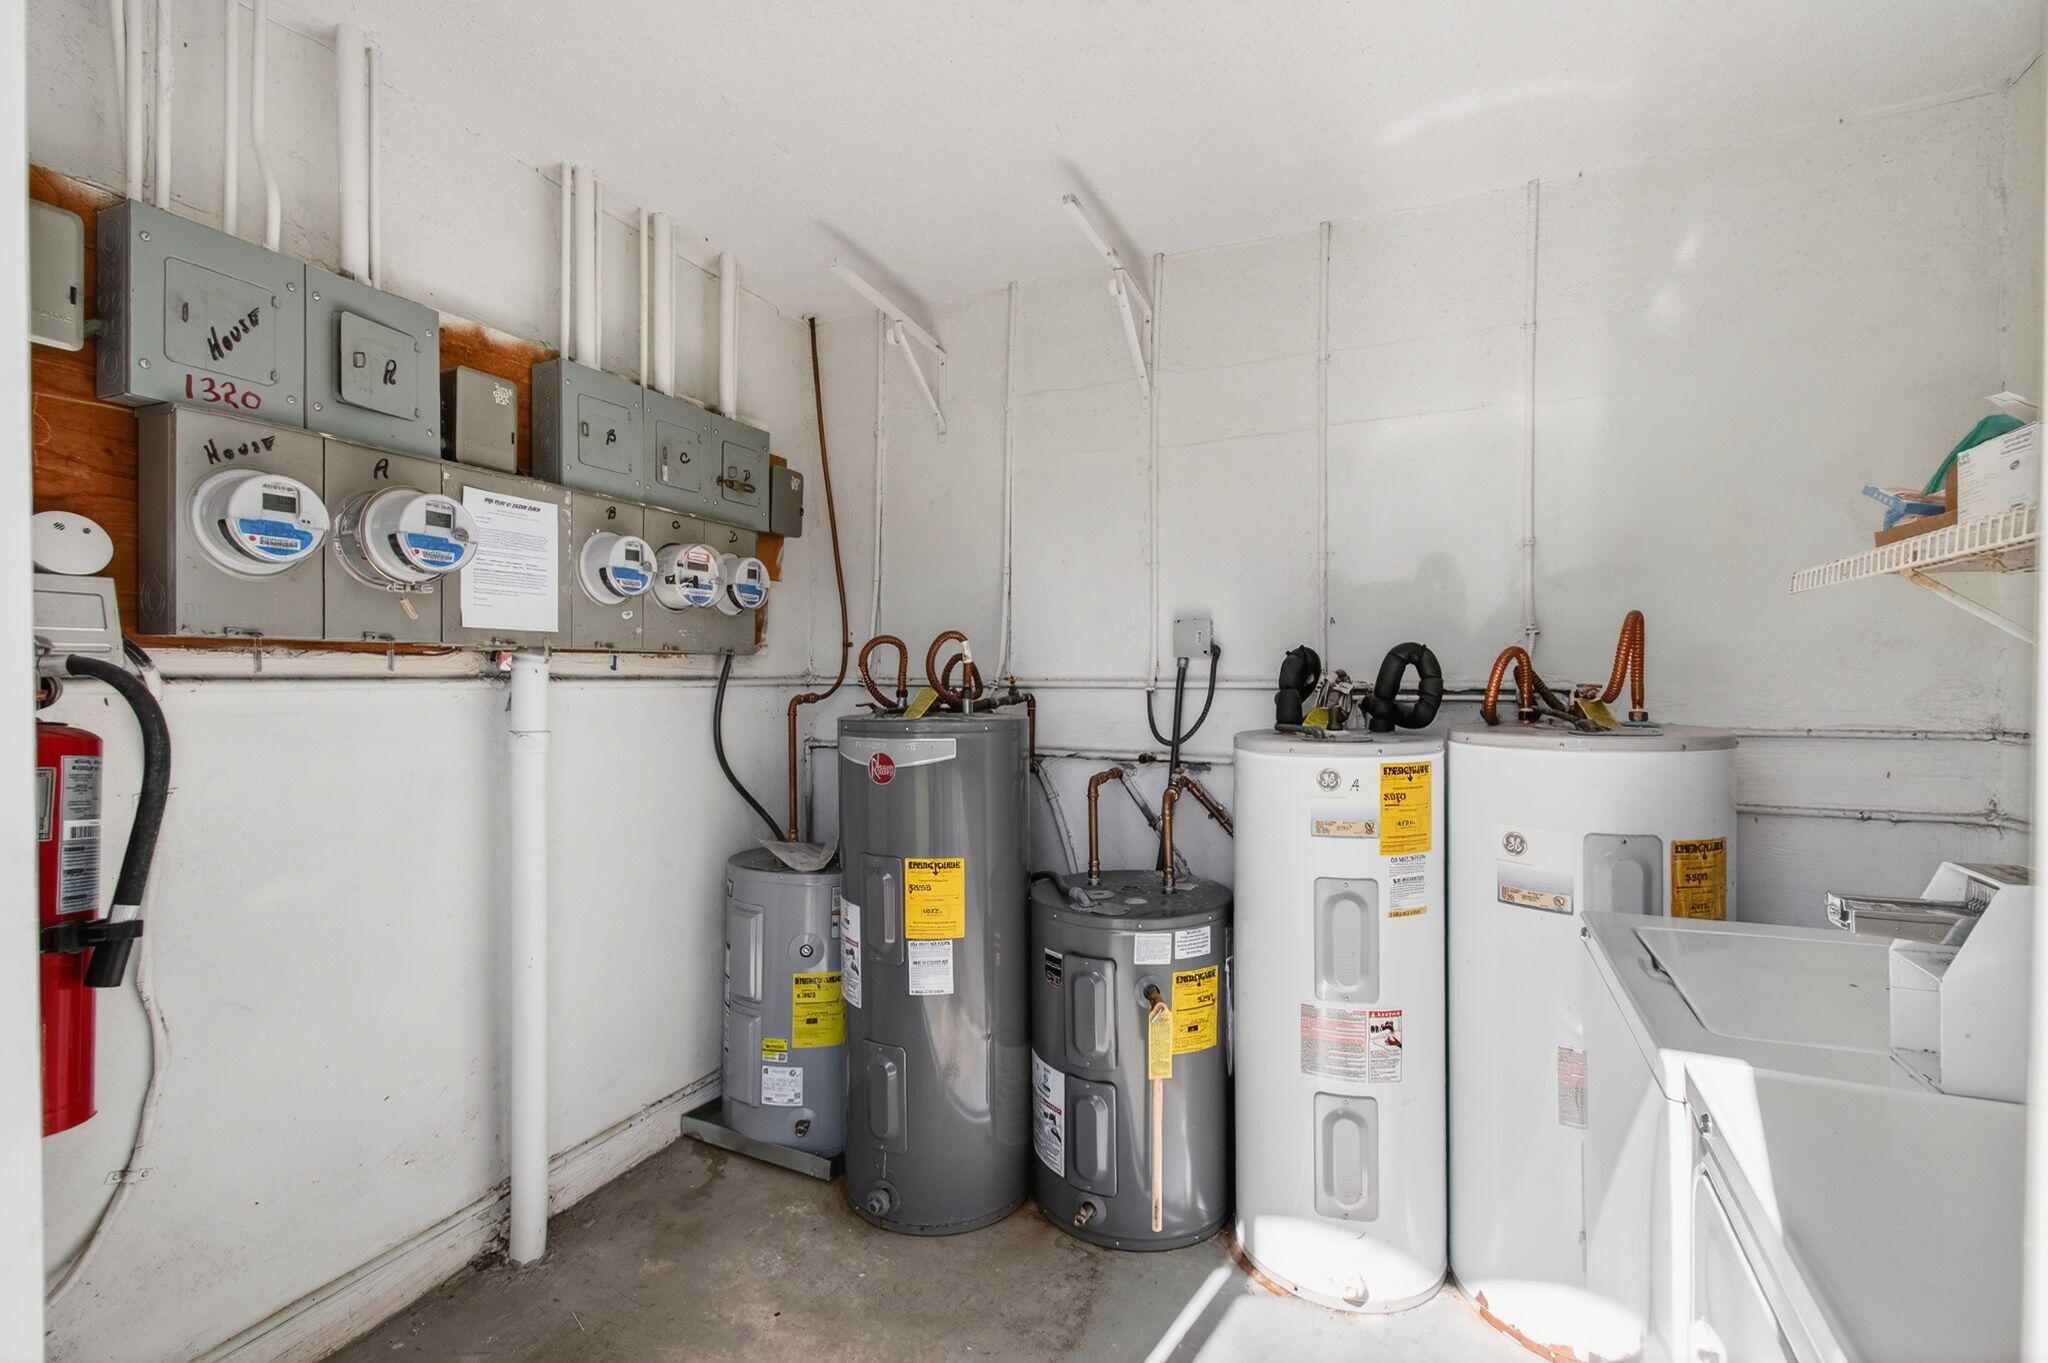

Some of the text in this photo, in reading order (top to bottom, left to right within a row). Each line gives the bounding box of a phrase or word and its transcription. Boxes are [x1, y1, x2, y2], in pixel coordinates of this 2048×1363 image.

[185, 373, 262, 409] 1320
[606, 428, 617, 445] B
[680, 452, 691, 464] C
[373, 458, 389, 480] A
[743, 469, 751, 482] D
[605, 506, 616, 520] B
[728, 530, 738, 543] D
[1350, 779, 1360, 791] A
